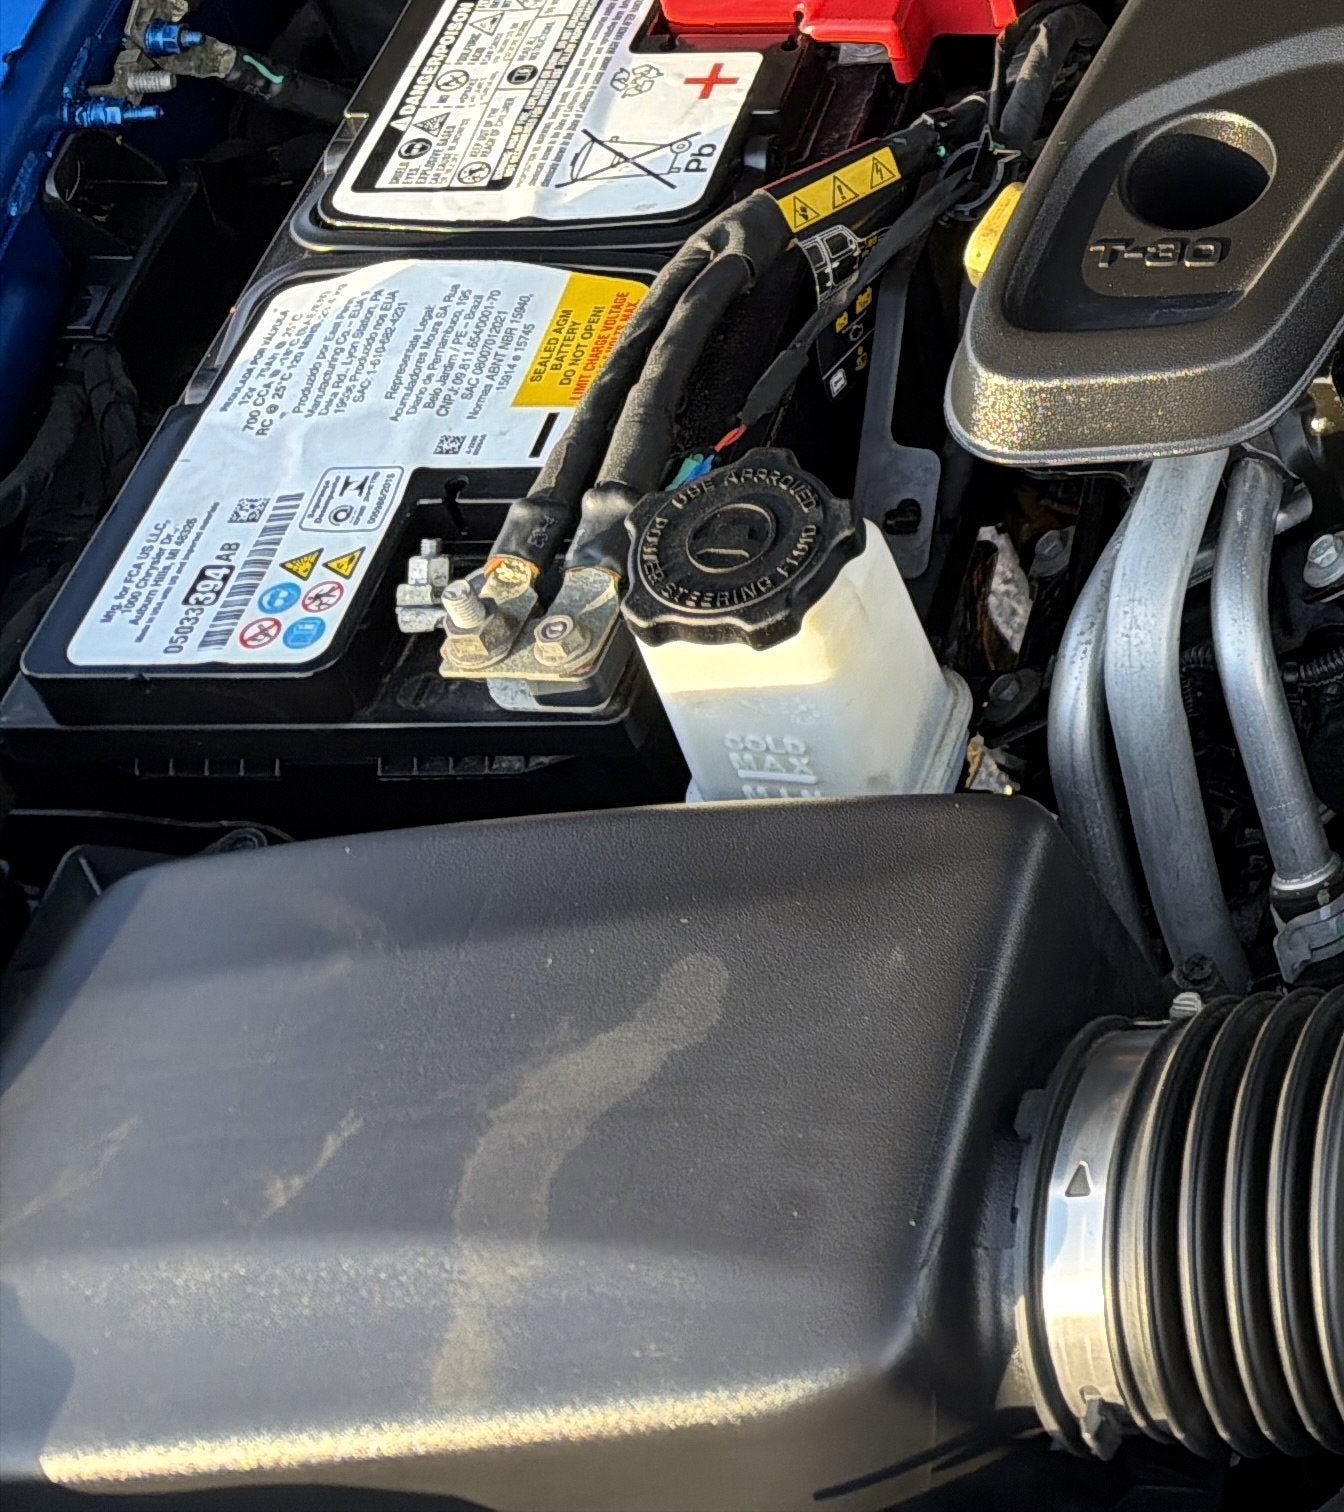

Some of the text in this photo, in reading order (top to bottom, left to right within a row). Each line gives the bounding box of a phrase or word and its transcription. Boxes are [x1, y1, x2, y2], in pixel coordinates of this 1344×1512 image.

[396, 1, 476, 115] DANGER/POISON
[683, 143, 717, 173] Pb
[1089, 240, 1223, 268] T-30
[342, 341, 361, 364] Lyon
[348, 331, 378, 381] Produzido
[372, 313, 387, 330] nos
[380, 289, 398, 311] EUA
[390, 283, 460, 421] Acumuladores Moura SA Rua
[421, 372, 434, 384] de
[428, 308, 462, 369] Pernambuco,
[423, 387, 442, 408] Belo
[434, 353, 458, 386] Jardim
[451, 329, 467, 344] PE
[464, 294, 483, 319] Brazil
[460, 310, 508, 399] SAC 08007012021
[467, 383, 491, 419] Normas
[484, 350, 507, 381] ABNT
[497, 327, 517, 349] NBR
[509, 293, 532, 323] 15940,
[513, 323, 534, 351] 15745
[530, 309, 572, 382] SEALED AGM
[550, 320, 582, 370] BATTERY
[559, 369, 576, 385] DO
[568, 342, 588, 365] NOT
[569, 291, 628, 400] LIMIT CHARGE VOLTAGE
[241, 409, 262, 431] 700
[252, 380, 275, 406] CCA
[255, 418, 273, 435] RC
[268, 373, 296, 399] 25°C
[292, 362, 322, 413] Produzido
[316, 343, 331, 359] por
[304, 346, 342, 417] Manufacturing
[672, 478, 715, 510] USE
[99, 519, 170, 622] Mfg. for FCA US LLC,
[120, 591, 143, 613] 1000
[134, 547, 169, 588] Chrysler
[128, 589, 157, 624] Auburn
[150, 561, 174, 586] Hills,
[165, 548, 181, 559] MI
[659, 575, 773, 609] STEERING
[723, 731, 807, 756] COLD
[728, 751, 815, 777] MAX
